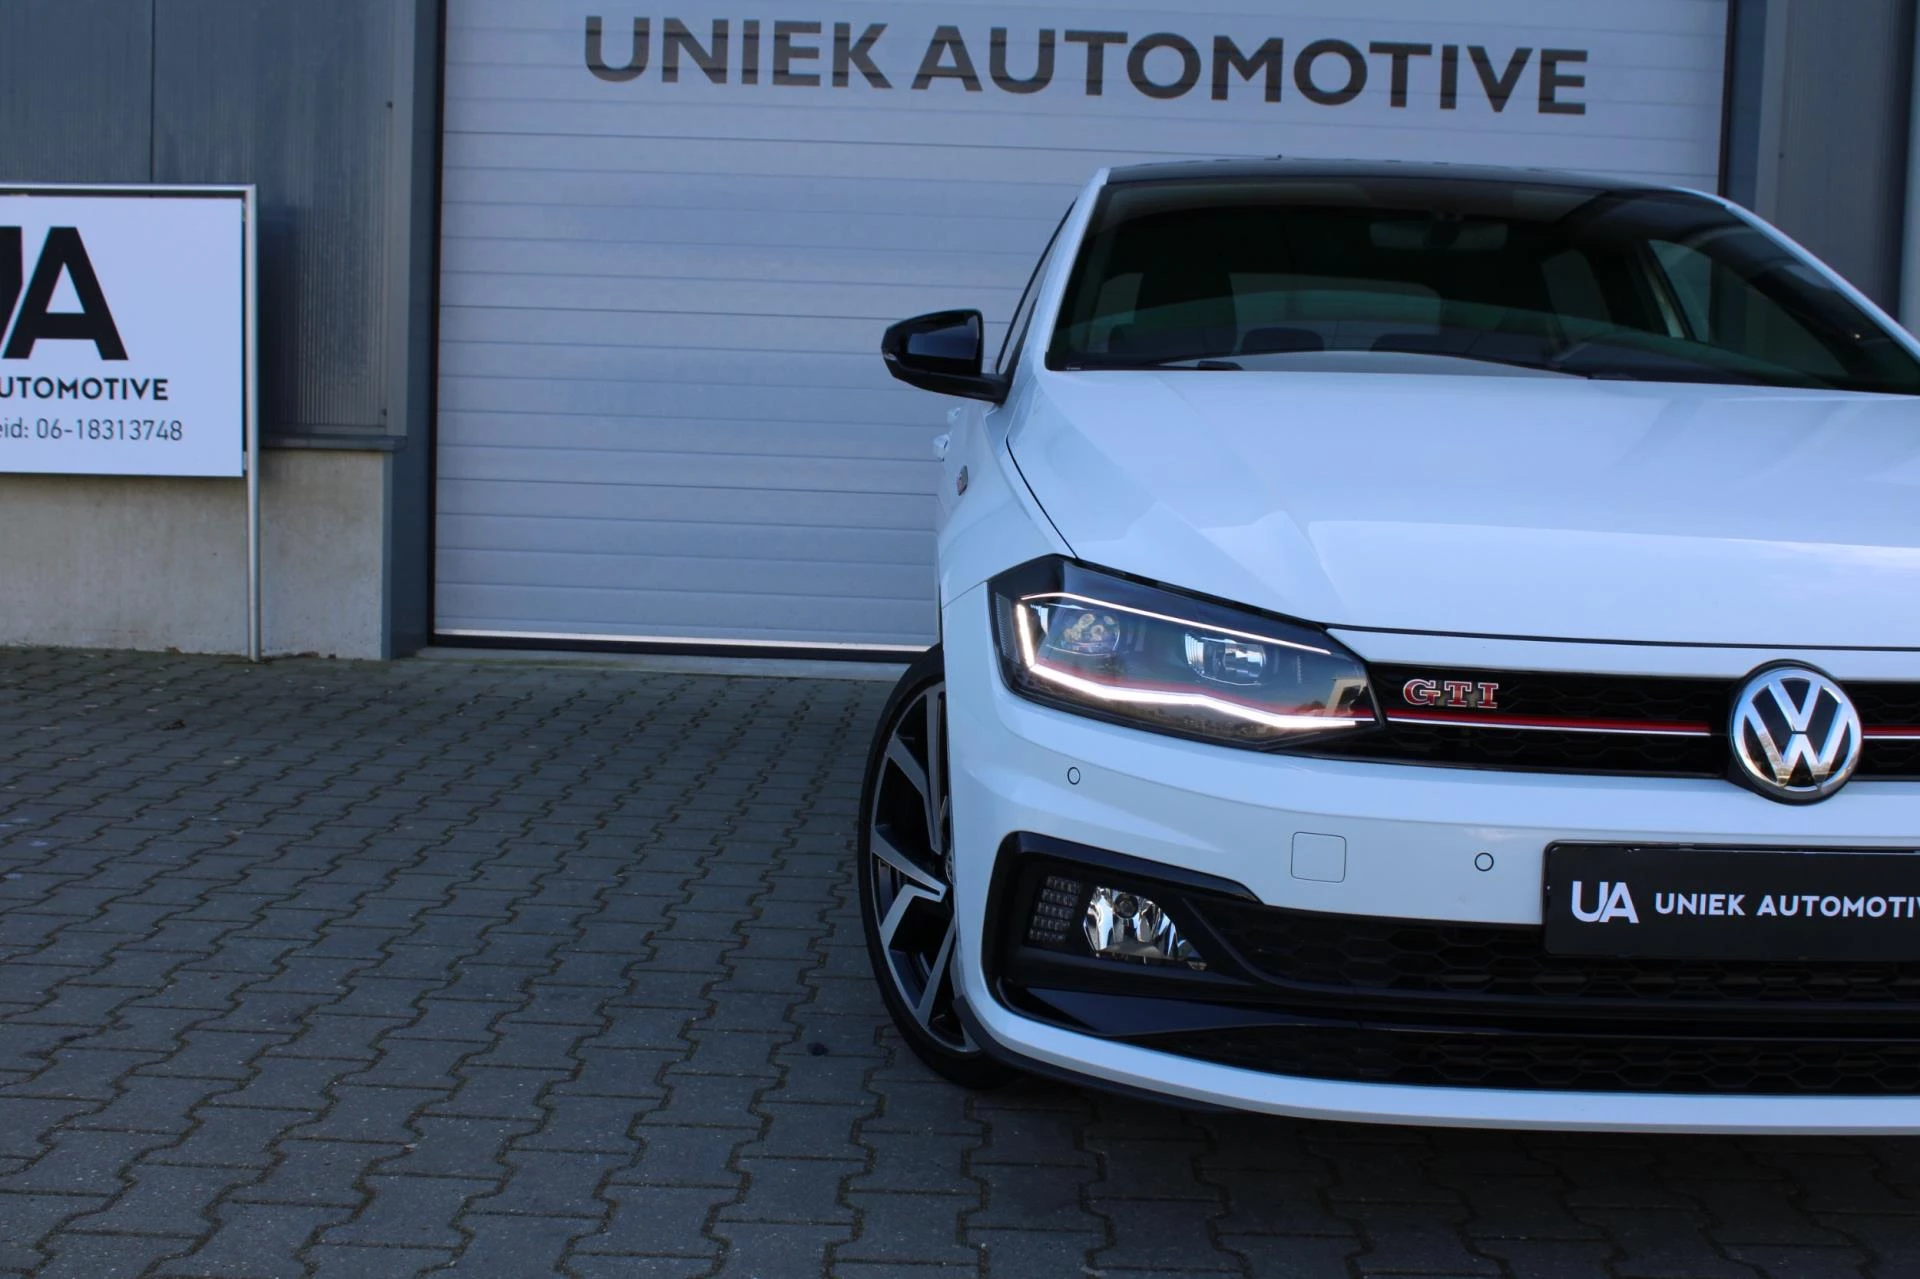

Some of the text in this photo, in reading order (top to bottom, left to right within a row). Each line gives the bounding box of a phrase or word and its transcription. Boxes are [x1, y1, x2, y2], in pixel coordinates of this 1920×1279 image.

[585, 15, 1588, 115] UNIEK AUTOMOTIVE
[36, 417, 183, 441] 06-18313748
[1402, 678, 1500, 710] GTI
[1571, 880, 1640, 924] UA
[1655, 892, 1920, 919] UNIEK AUTOMOTI
